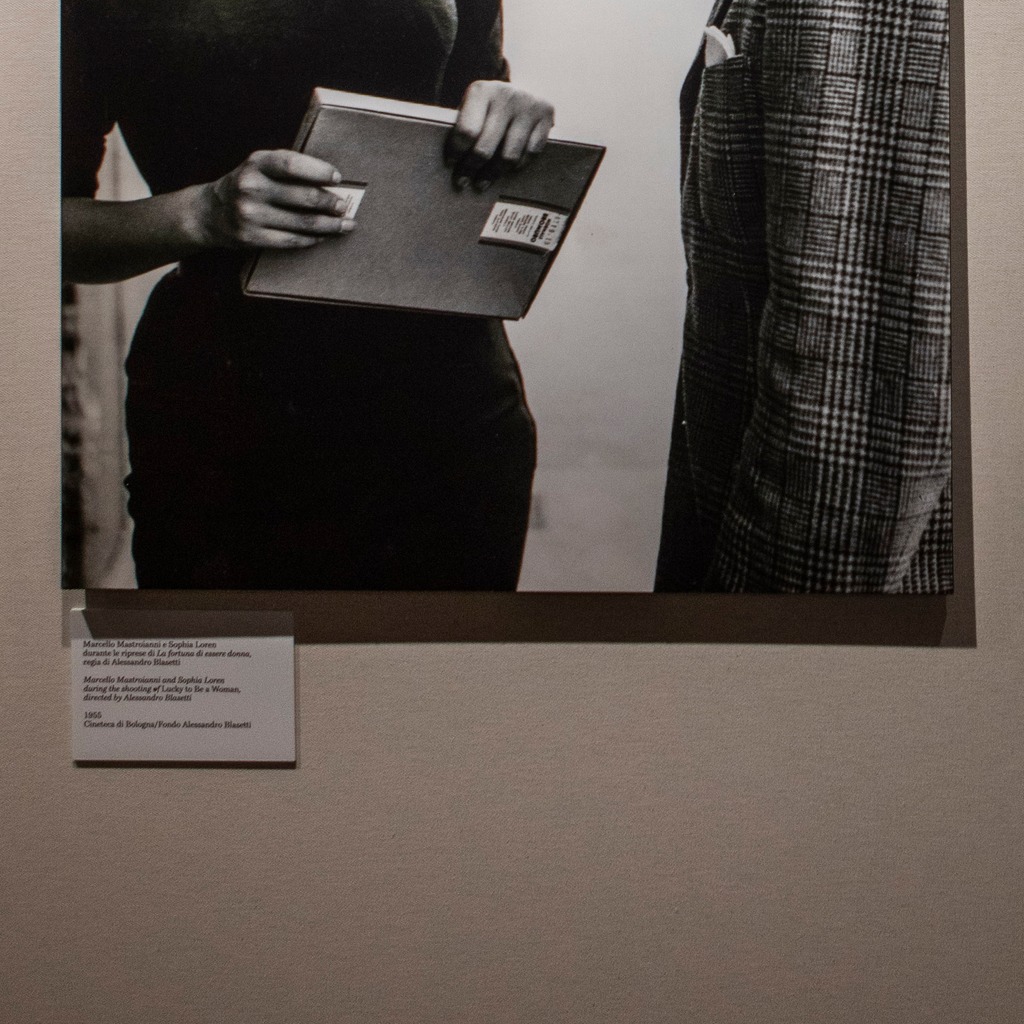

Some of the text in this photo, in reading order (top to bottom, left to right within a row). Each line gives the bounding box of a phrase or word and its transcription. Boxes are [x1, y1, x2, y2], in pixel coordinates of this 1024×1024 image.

[169, 641, 193, 649] Sophia
[168, 650, 194, 658] fortuna
[178, 676, 202, 685] Sophia
[121, 686, 151, 694] shooting
[162, 686, 183, 694] Lucky
[114, 694, 122, 702] by
